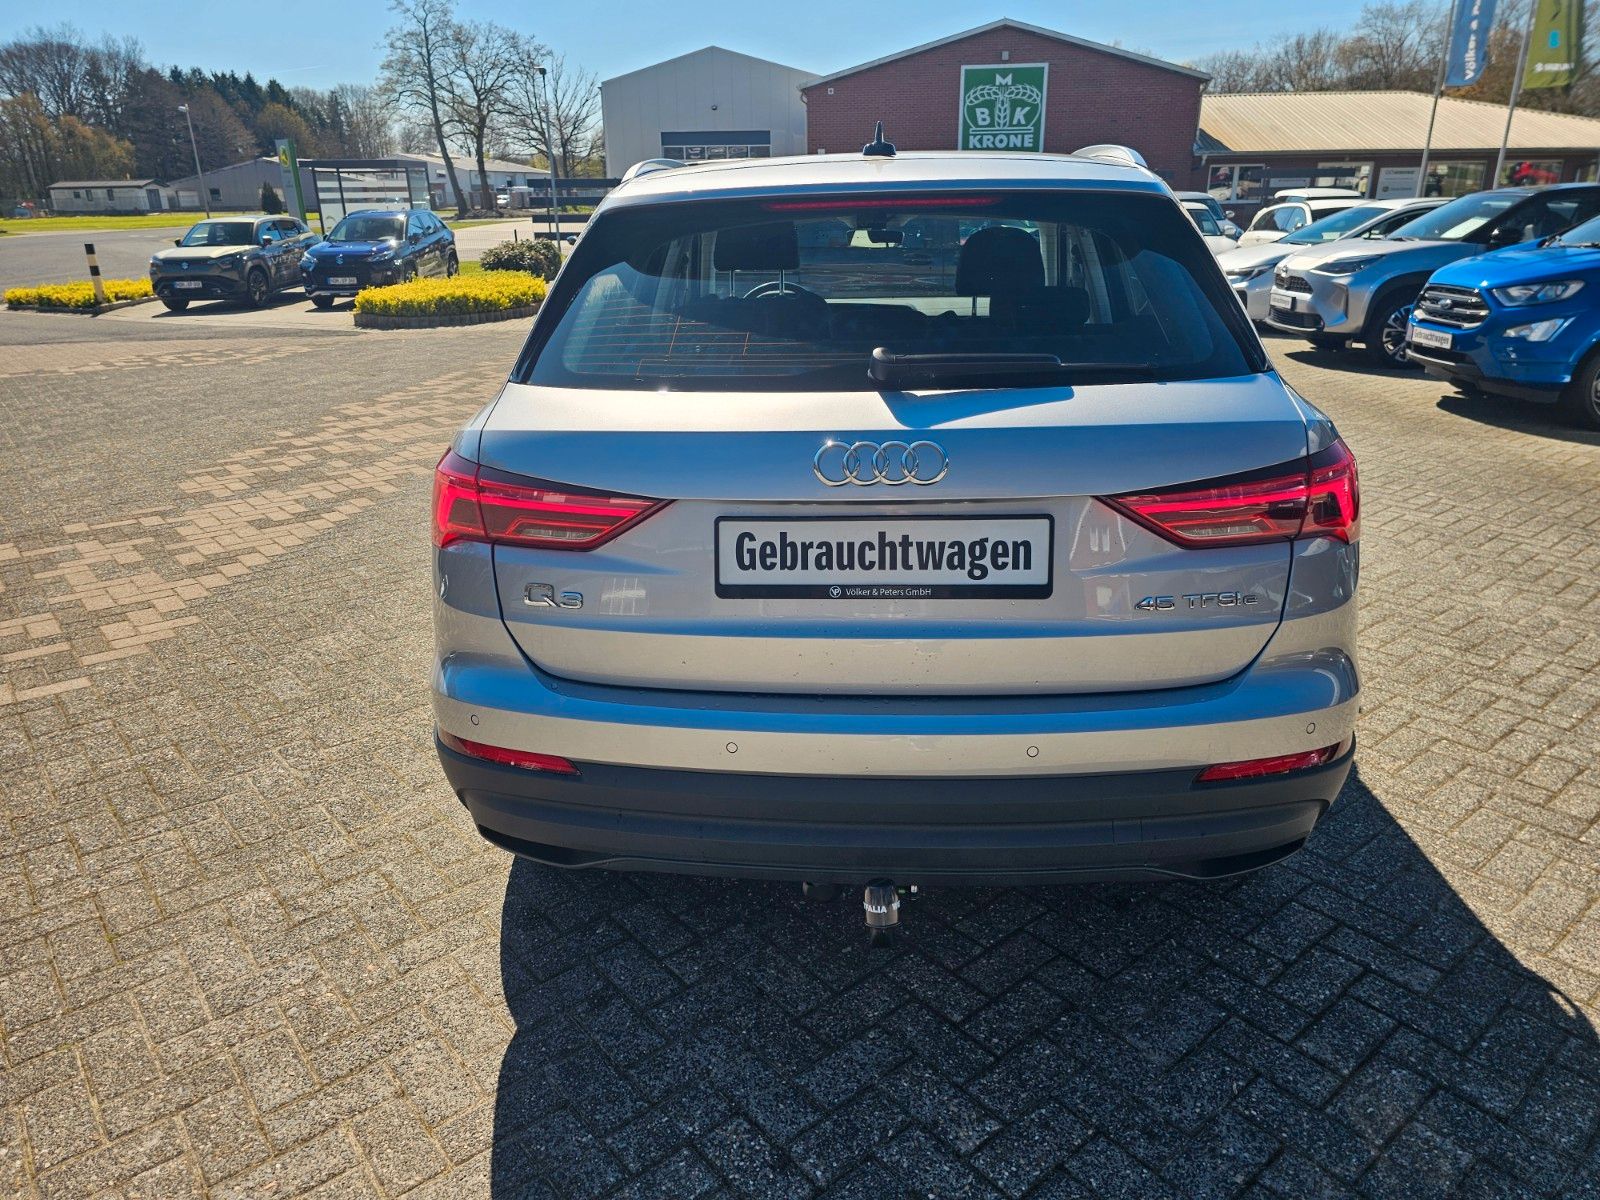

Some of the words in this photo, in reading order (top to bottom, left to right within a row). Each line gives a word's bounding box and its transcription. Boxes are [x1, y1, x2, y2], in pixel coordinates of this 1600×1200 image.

[995, 73, 1013, 86] M
[975, 107, 991, 126] B
[1012, 106, 1031, 125] K
[969, 134, 1034, 149] KRONE
[735, 531, 1032, 581] Gebrauchtwagen
[524, 583, 584, 609] Q3
[845, 588, 870, 596] Völker
[872, 588, 879, 596] &
[880, 588, 904, 596] Peters
[905, 588, 932, 596] GmbH
[1135, 596, 1176, 611] 45
